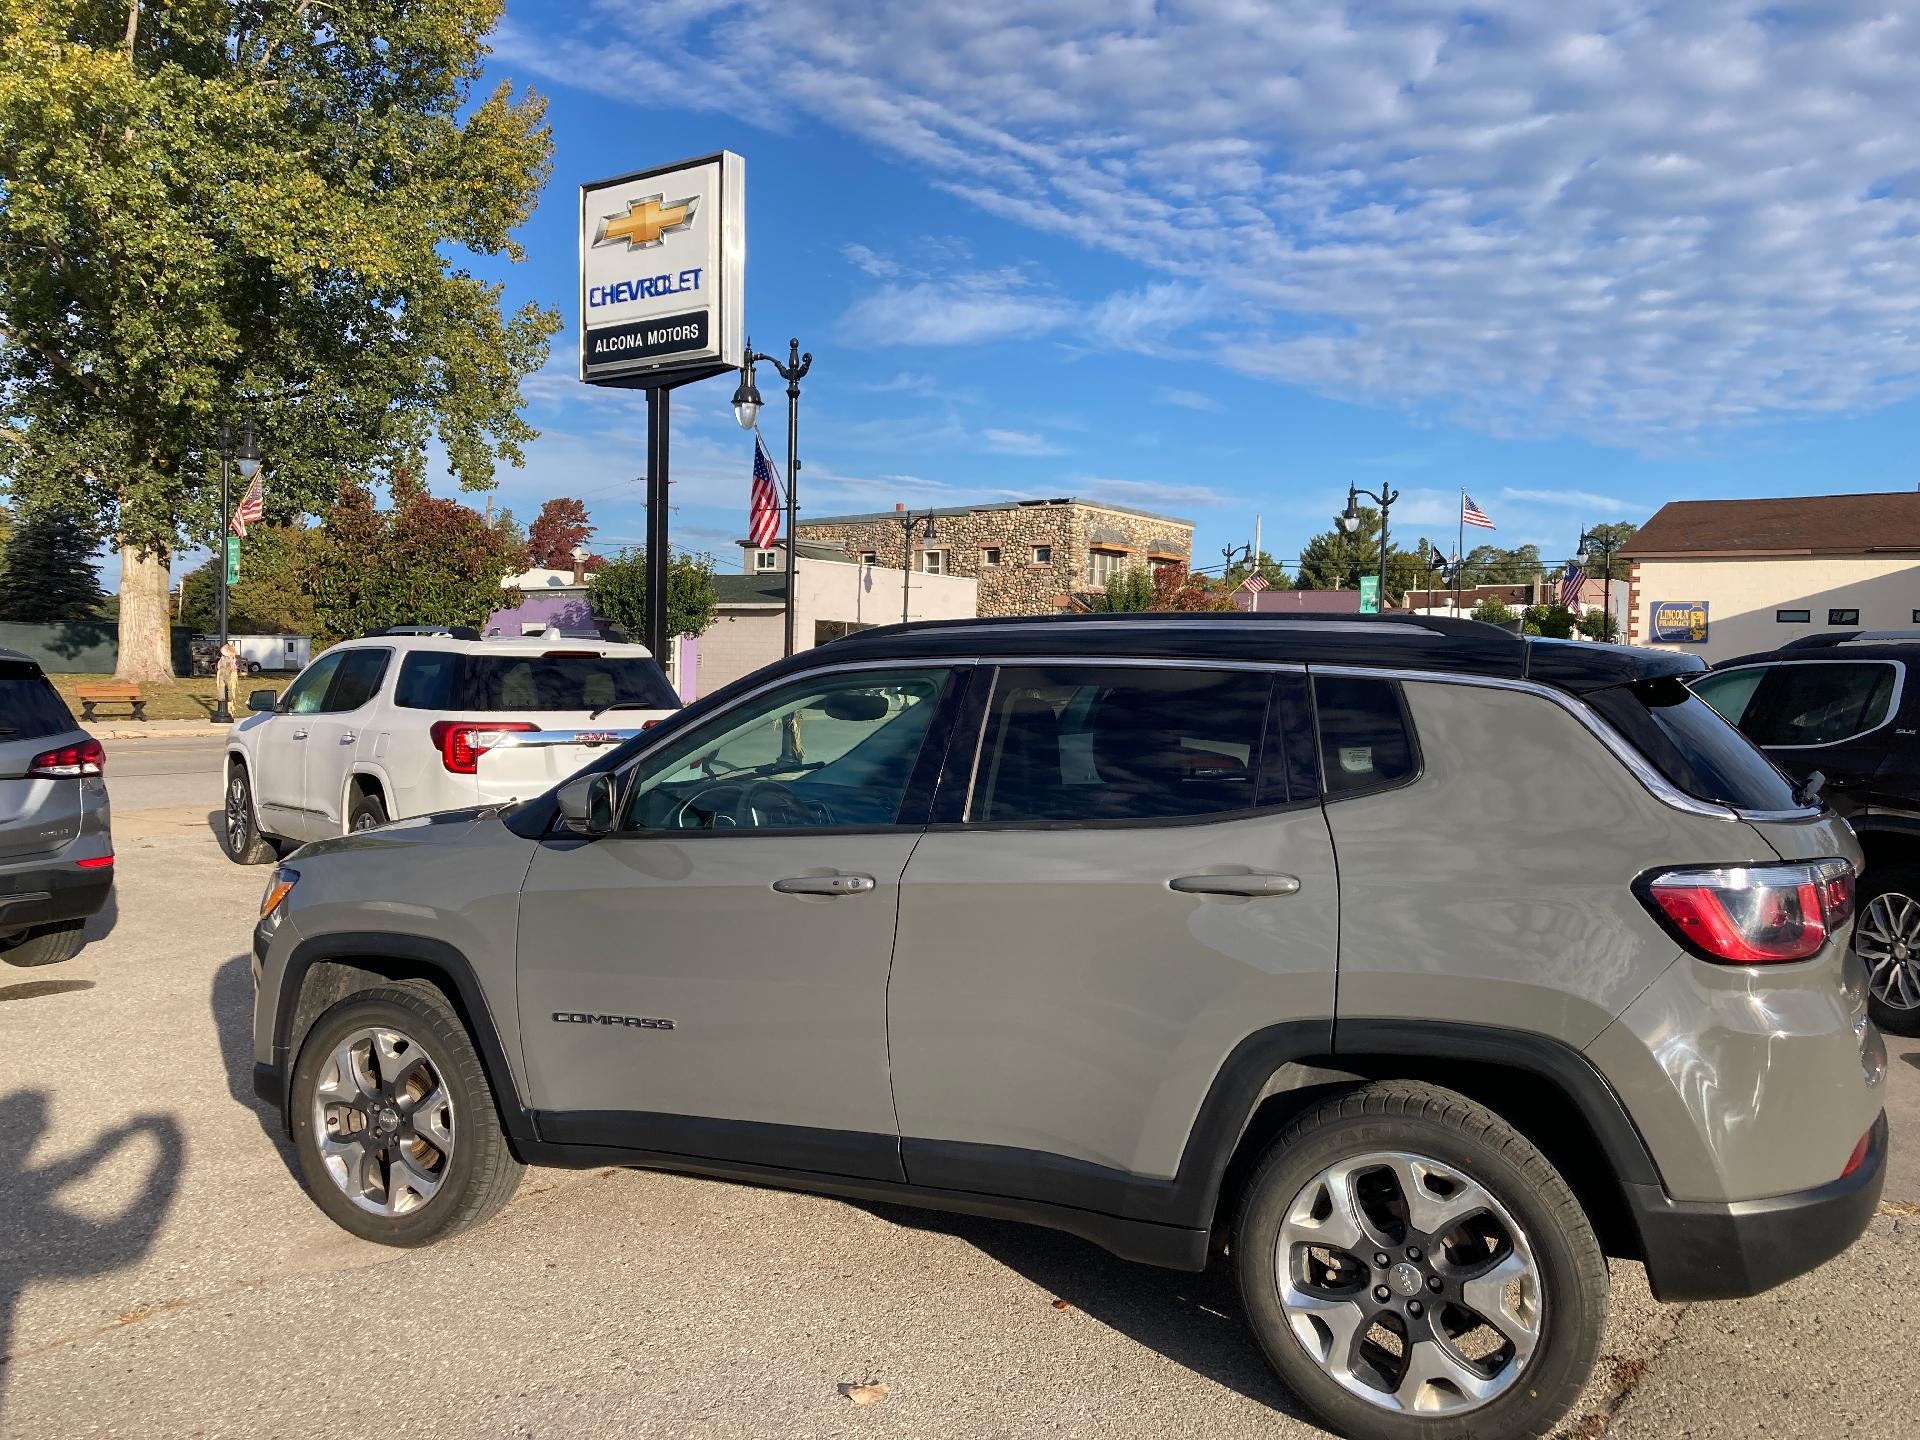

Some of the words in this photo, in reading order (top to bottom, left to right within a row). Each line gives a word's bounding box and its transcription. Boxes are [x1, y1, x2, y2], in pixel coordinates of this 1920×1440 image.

[590, 268, 703, 308] CHEVROLET
[595, 333, 643, 353] ALCONA
[647, 324, 699, 345] MOTORS
[1659, 609, 1690, 620] LINCOLN
[575, 732, 619, 741] GMC
[552, 1012, 675, 1030] COMPASS
